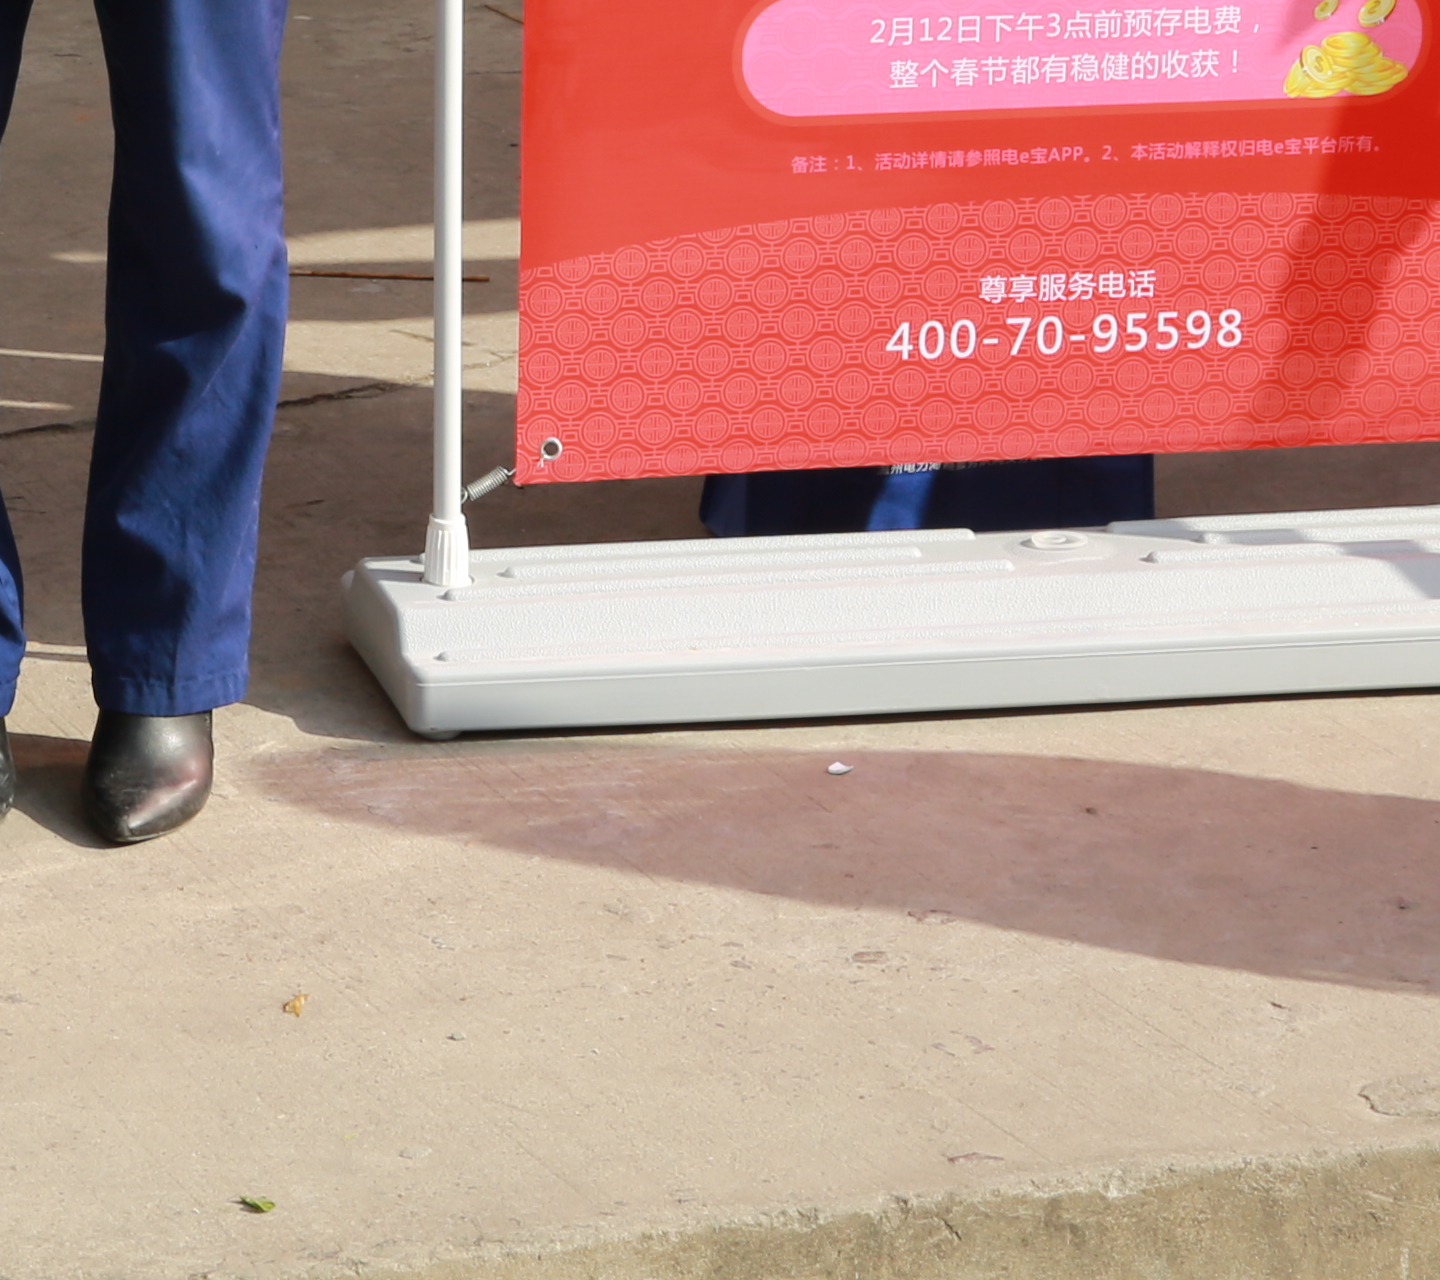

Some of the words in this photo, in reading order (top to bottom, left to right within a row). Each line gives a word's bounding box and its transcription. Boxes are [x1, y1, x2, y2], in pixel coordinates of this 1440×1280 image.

[979, 269, 1156, 304] 尊享服务电话
[885, 309, 1242, 361] 400-70-95598
